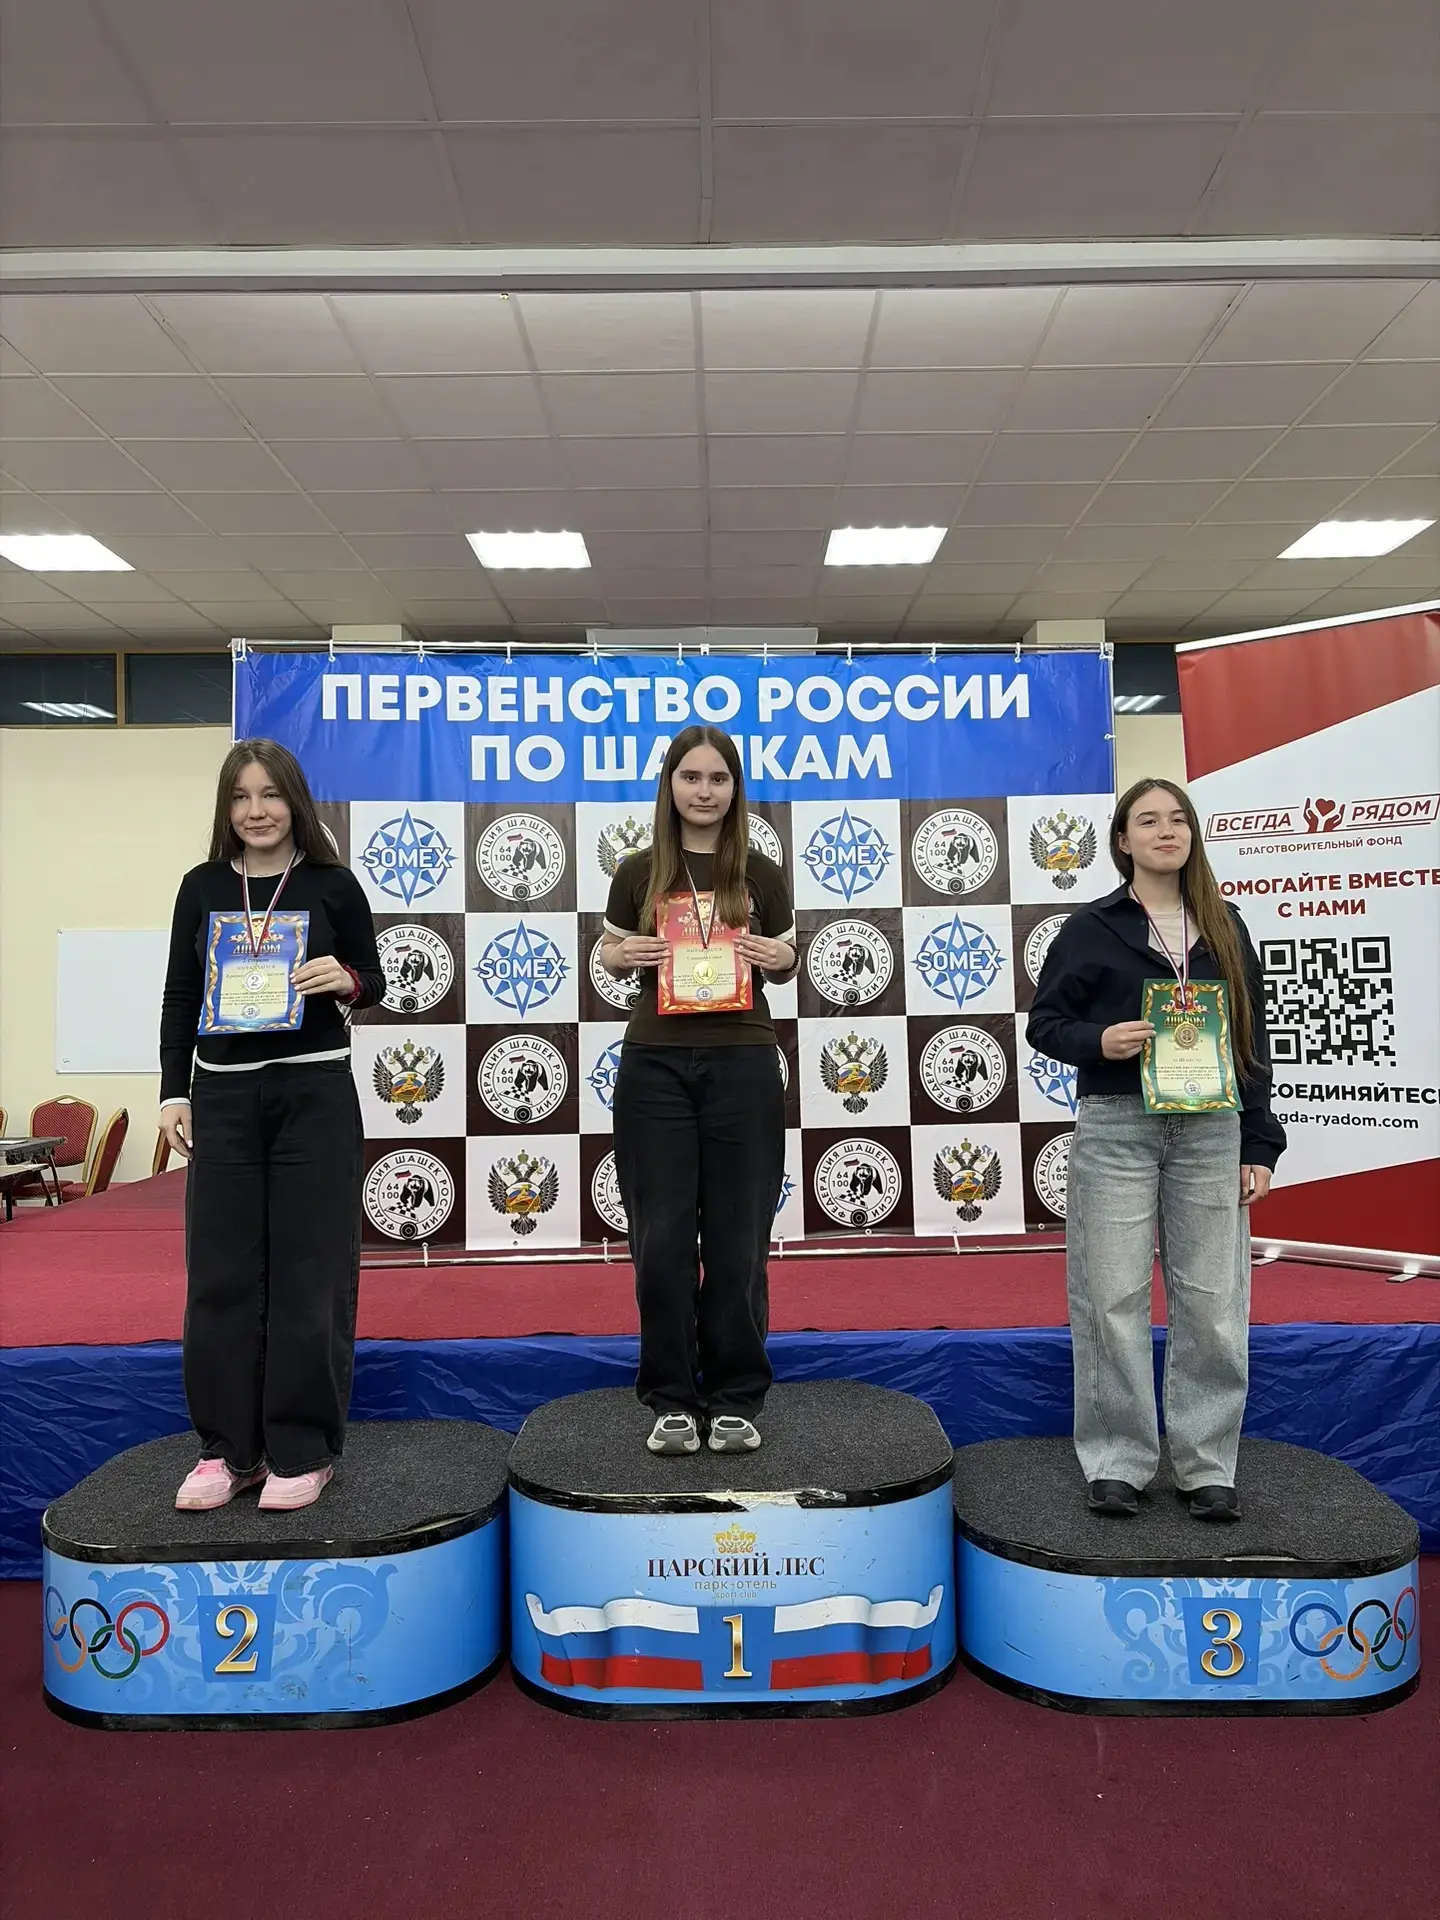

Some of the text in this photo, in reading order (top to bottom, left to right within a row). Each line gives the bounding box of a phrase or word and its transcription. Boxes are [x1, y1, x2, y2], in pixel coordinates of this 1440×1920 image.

[321, 673, 1031, 723] ПЕРВЕНСТВО РОССИИ
[470, 734, 893, 782] ПО ШАКАМ
[1215, 799, 1432, 832] ВСЕГДА РЯДОМ
[363, 846, 453, 868] SOMEX
[482, 819, 560, 892] ФЕДЕРАЦИЯ ШАШЕК РОССИИ
[804, 844, 890, 866] SOMEX
[918, 814, 993, 886] ФЕДЕРАЦИЯ ШАШЕК РОССИИ
[1238, 835, 1403, 856] БЛАГОТВОРИТЕЛЬНЫЙ ФОНД
[1219, 868, 1440, 896] ОМОГАЙТЕ ВМЕСТЕ
[1277, 899, 1366, 918] С НАМИ
[251, 976, 259, 987] 2
[394, 930, 448, 1004] ШАШЕК РОССИИ
[477, 957, 567, 979] SOMEX
[813, 925, 888, 997] ФЕДЕРАЦИЯ ШАШЕК РОССИИ
[916, 949, 1002, 972] SOMEX
[483, 1047, 509, 1115] ФЕДЕРАЦИЯ
[509, 1040, 555, 1061] ШАШЕК
[536, 1064, 563, 1114] РОССИИ
[925, 1031, 1001, 1104] ФЕДЕРАЦИЯ ШАШЕК РОССИИ
[1029, 1057, 1078, 1078] SOM
[369, 1155, 449, 1230] ФЕДЕРАЦИЯ ШАШЕК РОССИИ
[820, 1151, 846, 1218] ФЕДЕРАЦИЯ
[844, 1144, 888, 1164] ШАШЕК
[871, 1167, 896, 1217] РОССИИ
[1039, 1145, 1066, 1212] ФЕДЕРАЦИЯ
[647, 1552, 825, 1581] ЦАРСКИЙ ЛЕС
[215, 1604, 258, 1673] 2
[722, 1613, 752, 1678] 1
[1201, 1607, 1245, 1677] 3
